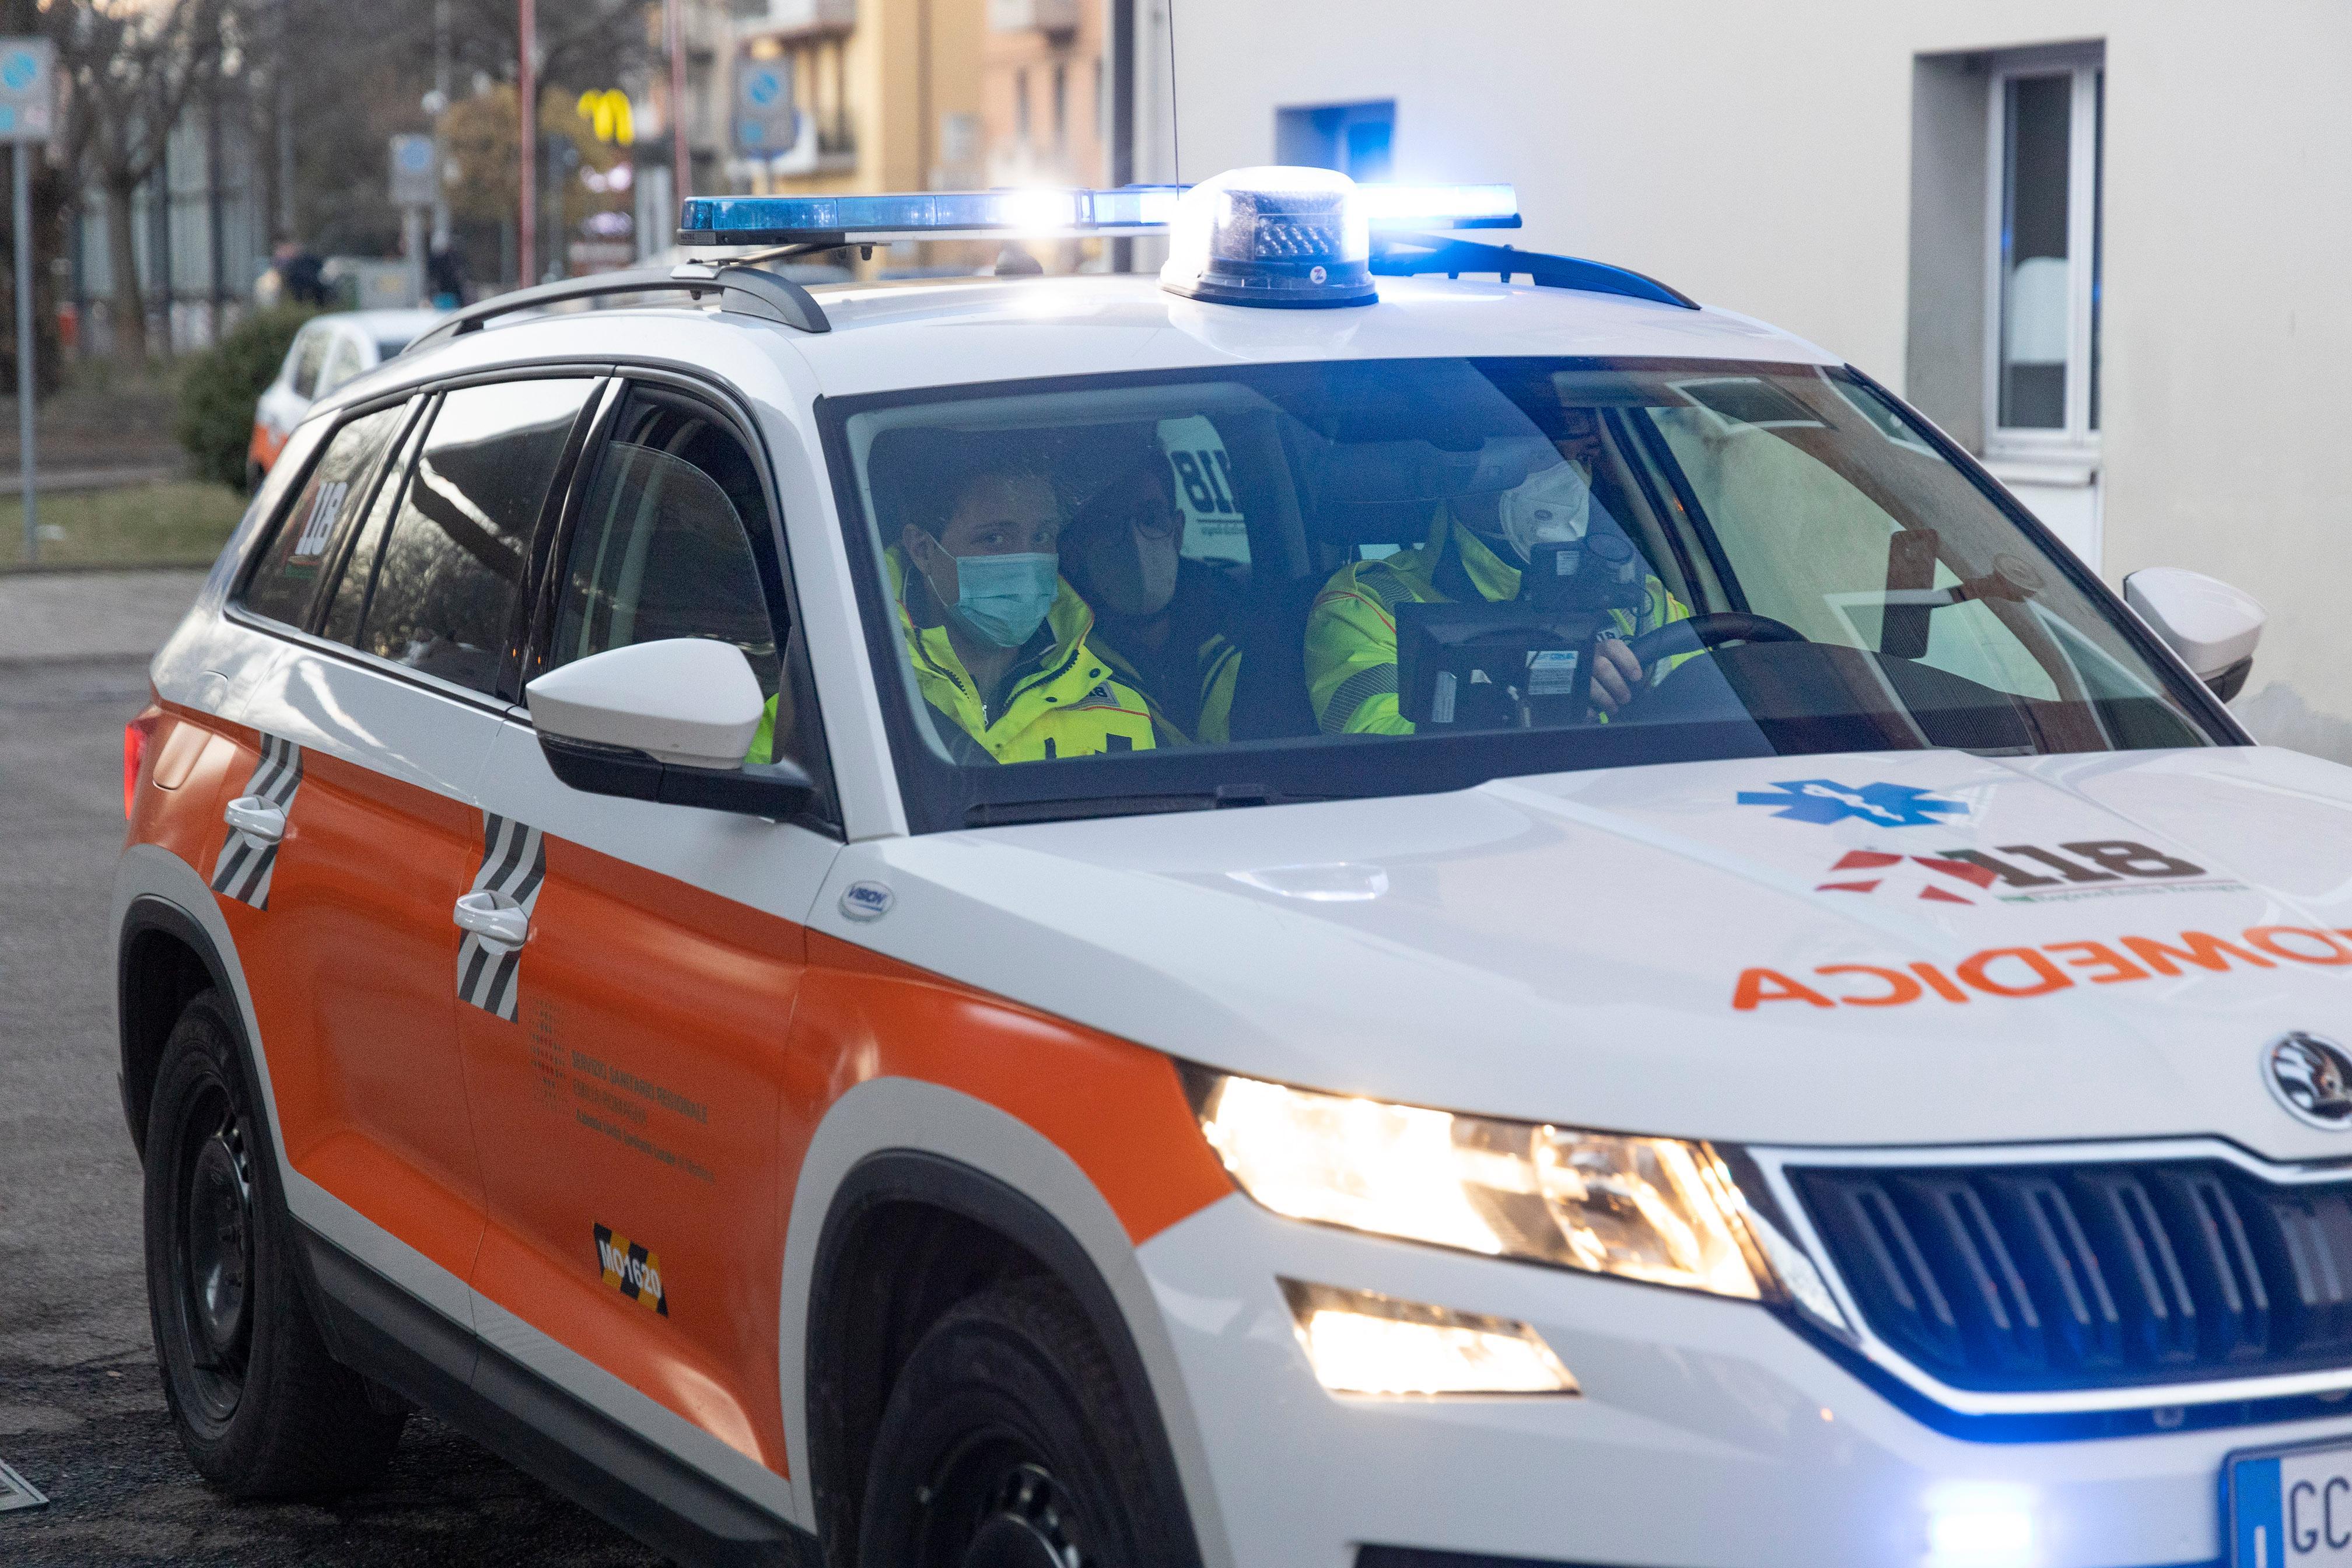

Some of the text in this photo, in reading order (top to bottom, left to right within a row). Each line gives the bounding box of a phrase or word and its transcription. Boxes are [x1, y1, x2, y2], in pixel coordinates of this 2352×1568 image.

[295, 481, 348, 555] 118
[1936, 840, 2207, 888] 118
[598, 1240, 662, 1298] MO1620
